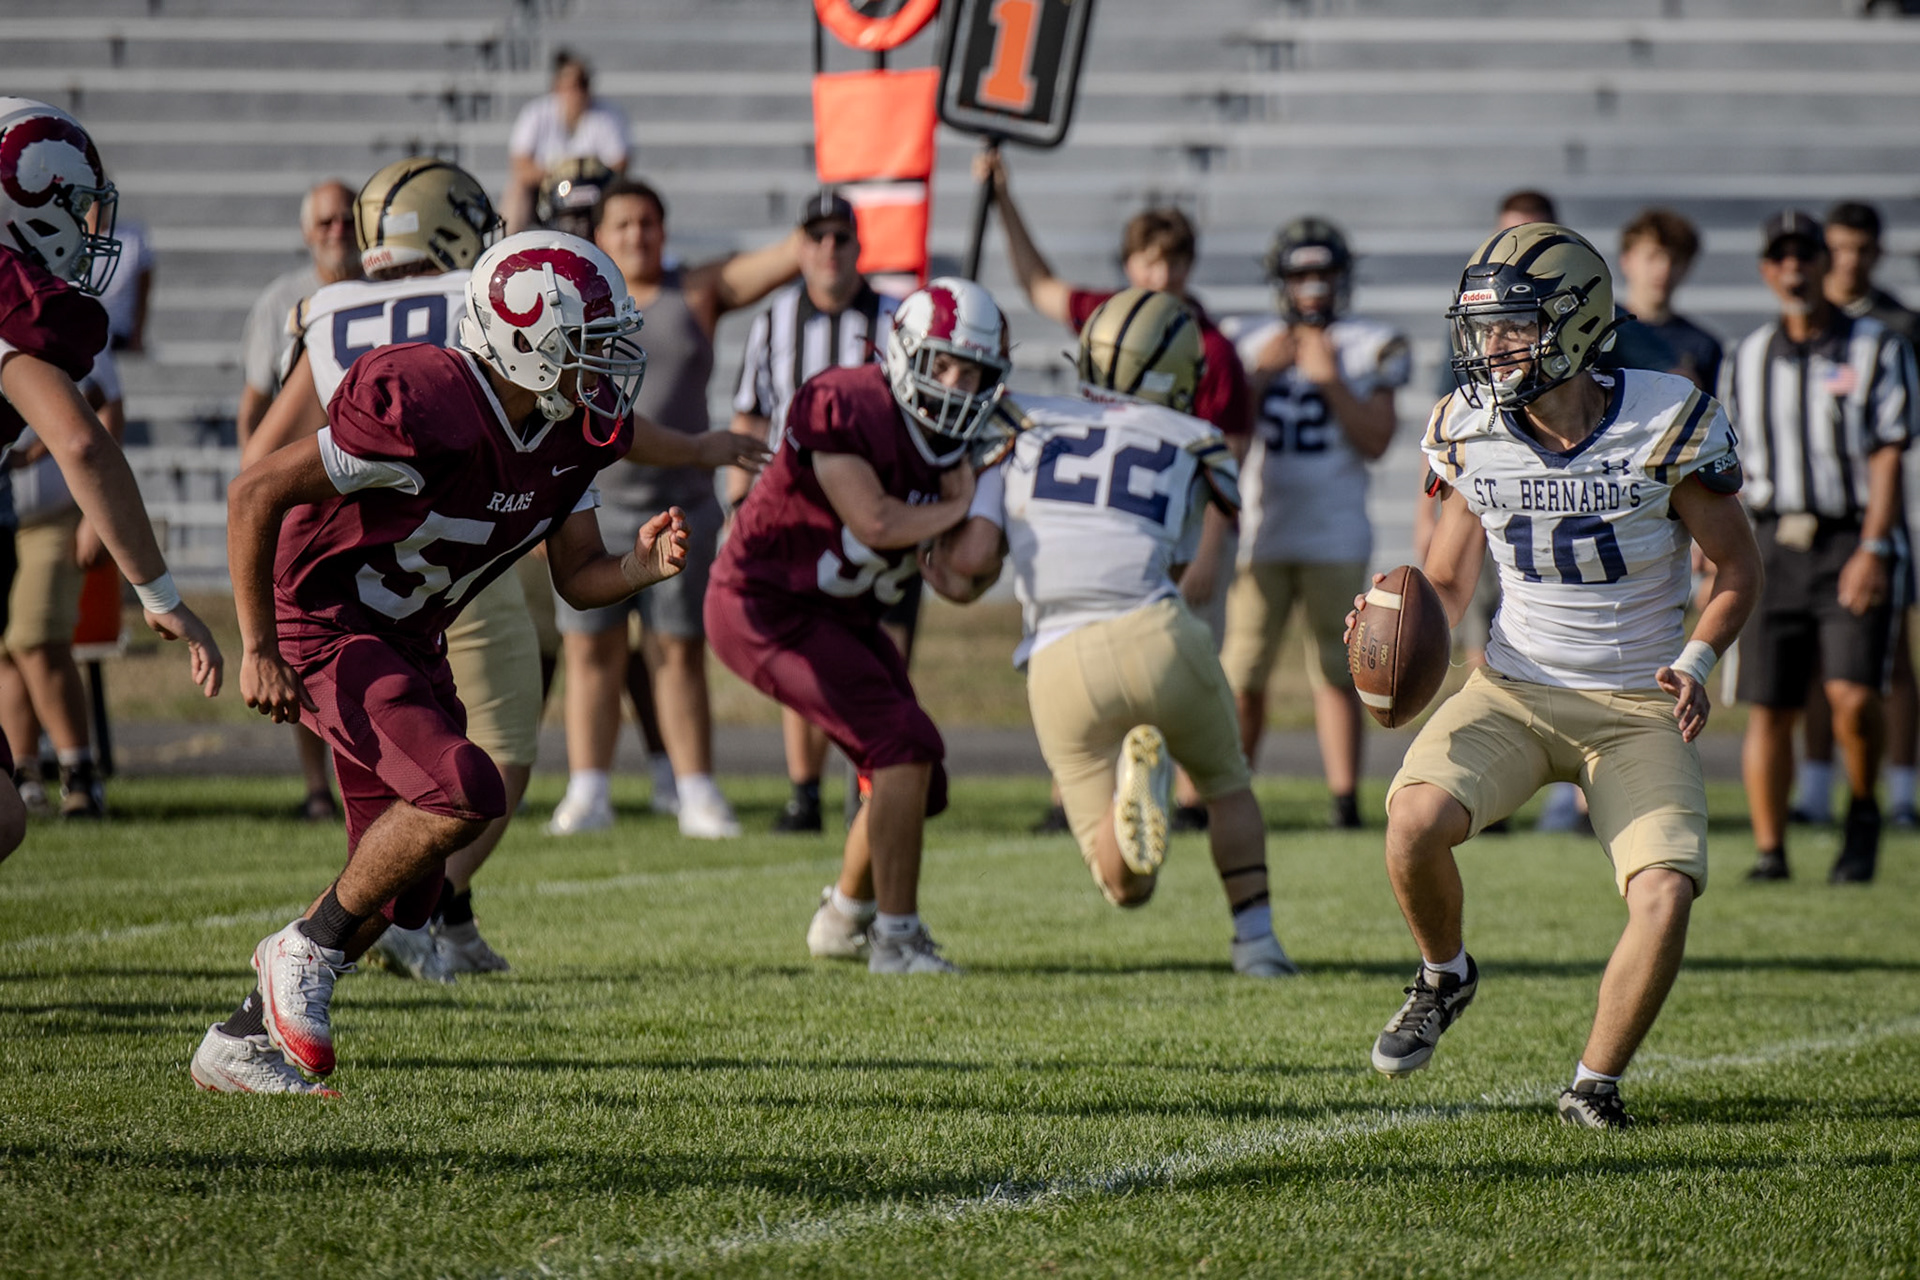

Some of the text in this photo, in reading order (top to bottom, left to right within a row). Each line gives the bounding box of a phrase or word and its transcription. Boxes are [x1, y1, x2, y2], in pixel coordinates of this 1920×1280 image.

[977, 0, 1042, 113] 1
[1261, 386, 1328, 454] 52
[486, 491, 535, 513] RAMS
[1031, 428, 1179, 526] 22
[1474, 478, 1641, 512] ST. BERNARD'S
[1504, 514, 1628, 584] 10
[1353, 621, 1366, 674] Wilson
